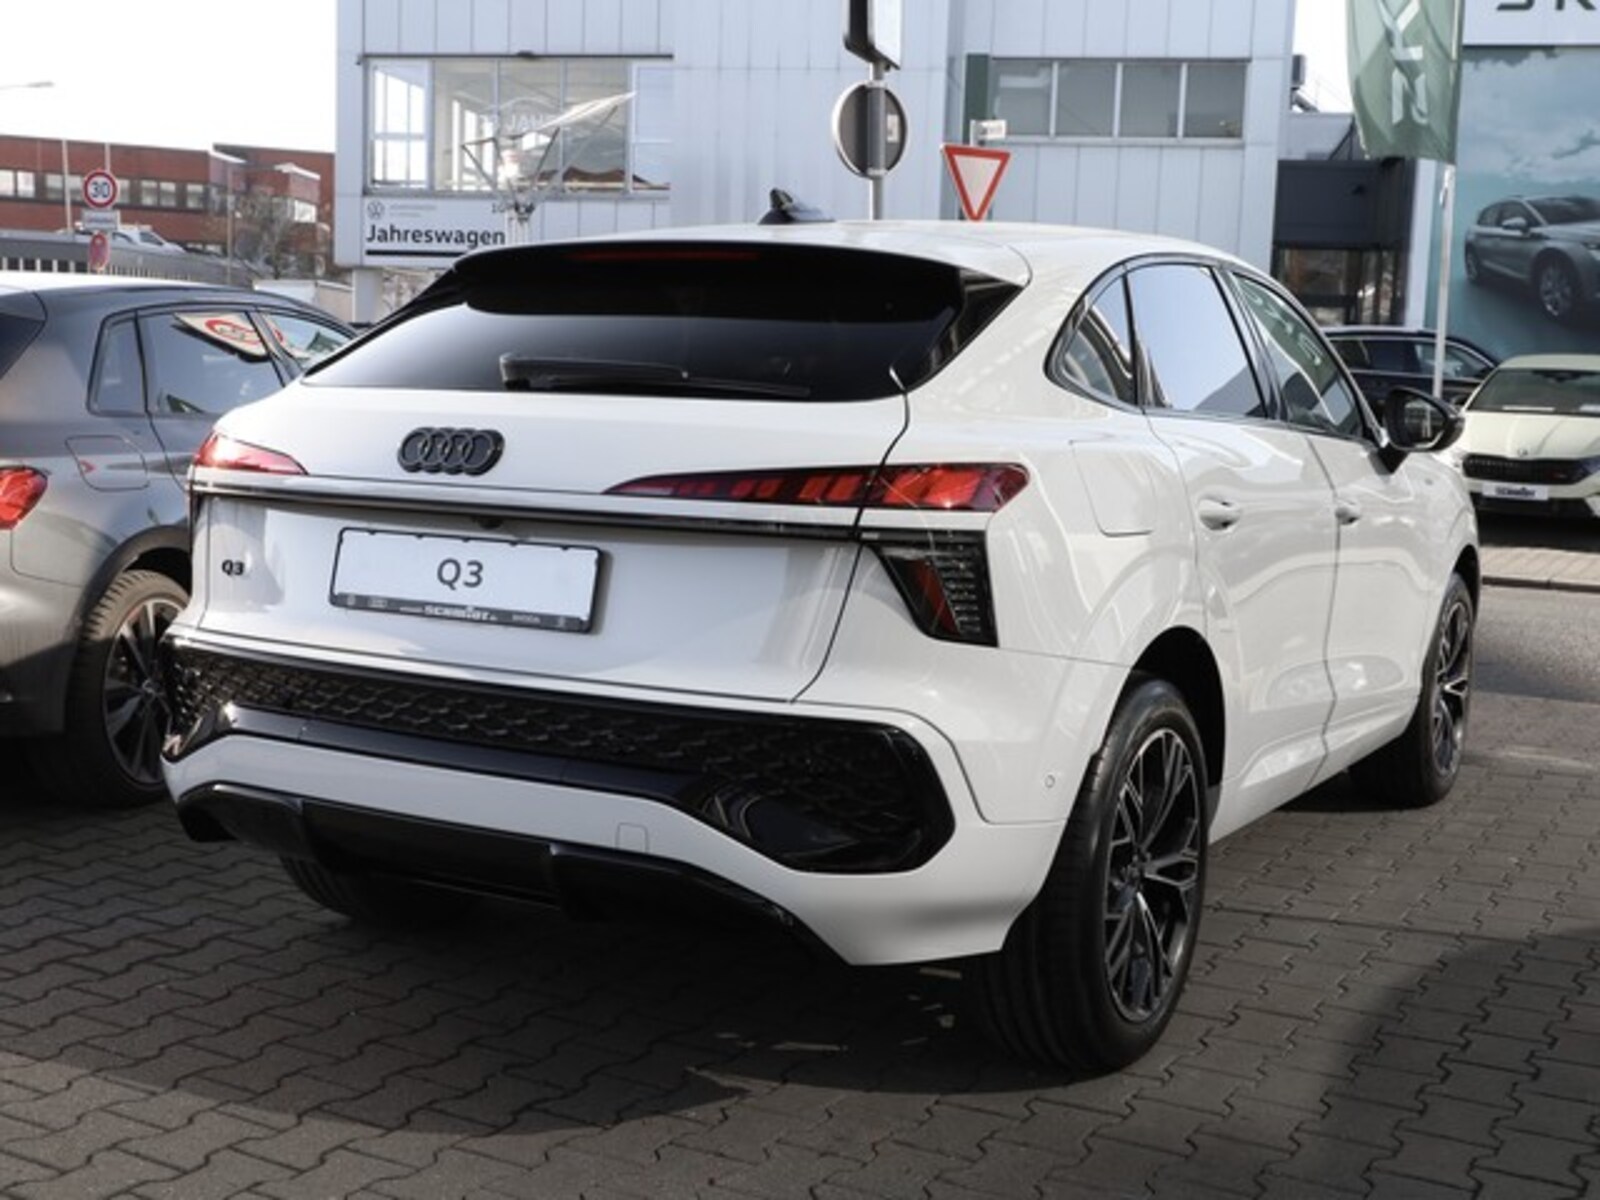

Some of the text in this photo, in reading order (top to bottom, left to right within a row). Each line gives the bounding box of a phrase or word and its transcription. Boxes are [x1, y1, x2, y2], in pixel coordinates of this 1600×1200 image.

[91, 181, 111, 198] 30
[365, 224, 506, 249] Jahreswagen
[221, 559, 244, 577] Q3
[436, 557, 484, 591] Q3
